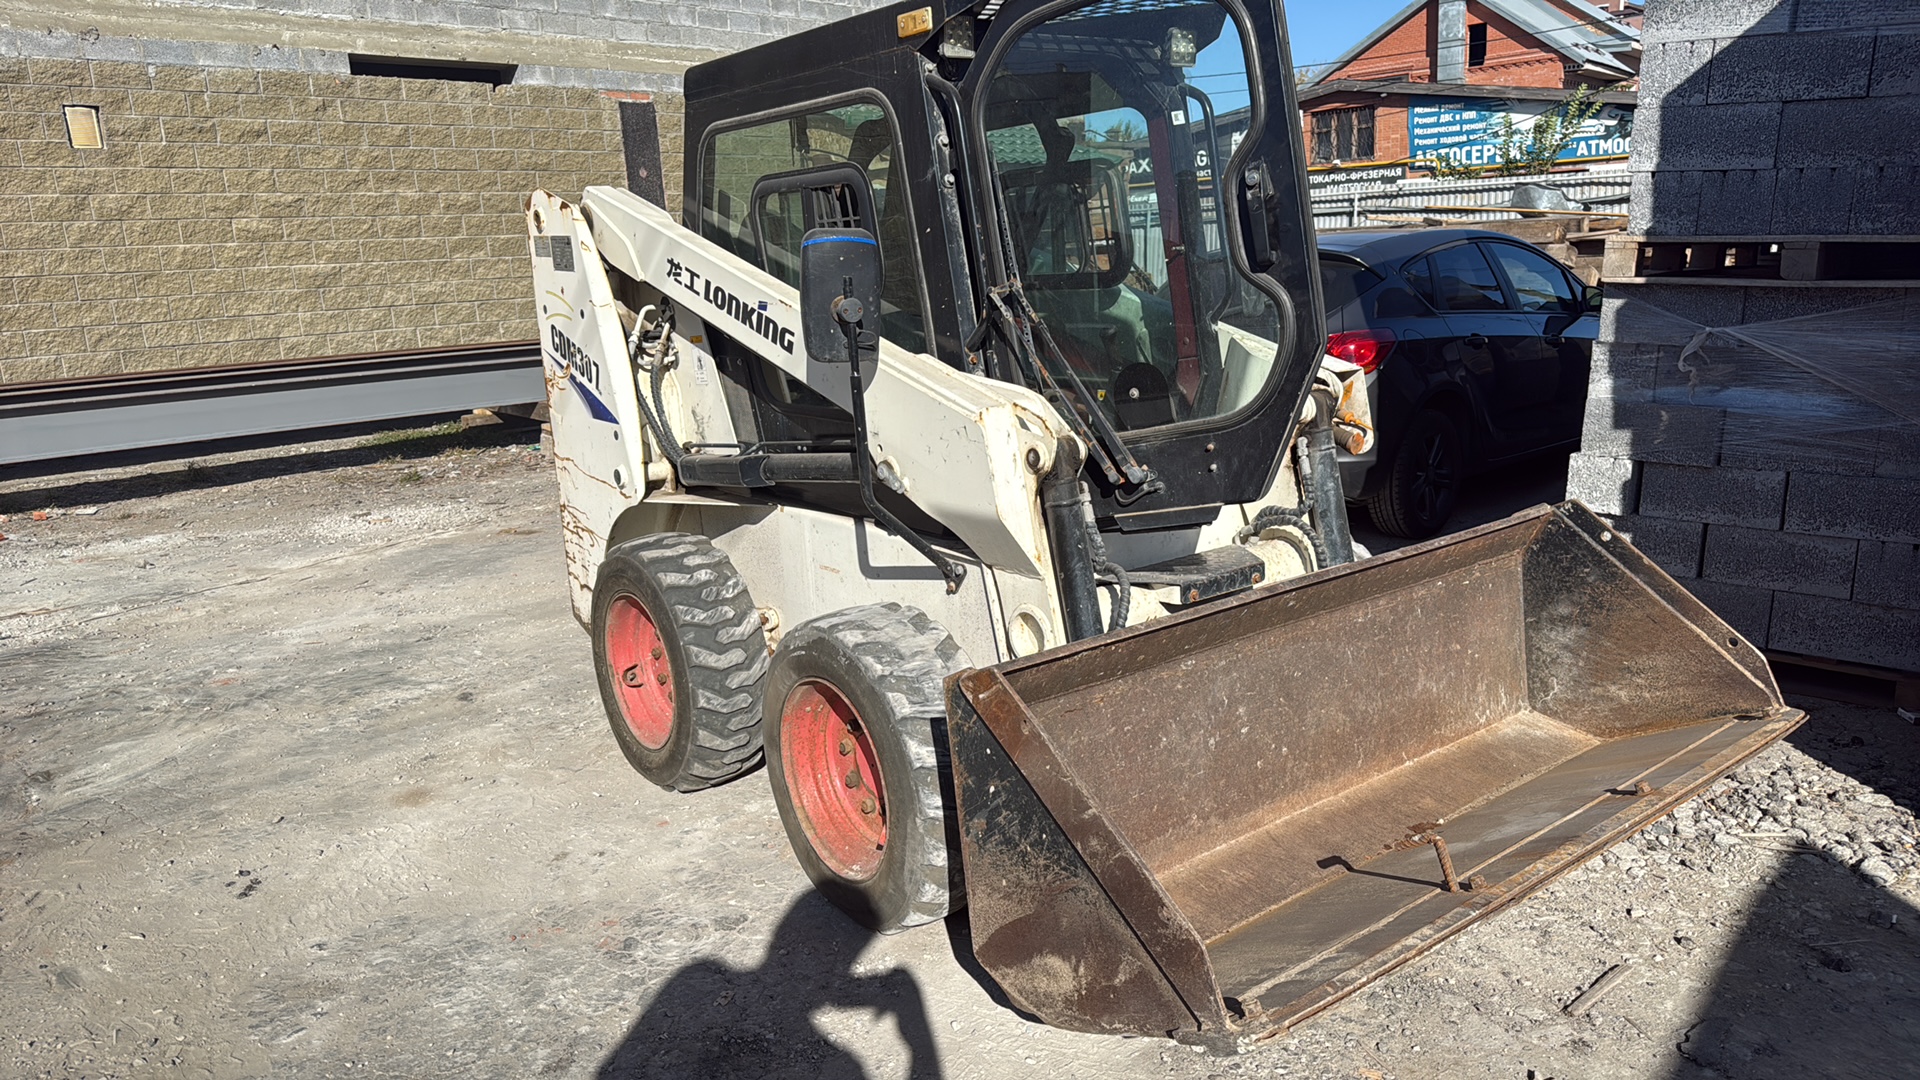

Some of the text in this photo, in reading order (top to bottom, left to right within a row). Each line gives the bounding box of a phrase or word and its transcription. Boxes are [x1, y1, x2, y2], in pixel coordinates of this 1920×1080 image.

[1414, 116, 1438, 125] Ремонт
[1439, 113, 1454, 123] ДВС
[1462, 111, 1476, 120] КПП
[1414, 121, 1487, 135] Механический ремонт
[1414, 137, 1438, 146] Ремонт
[1440, 134, 1467, 144] ходовой
[1308, 167, 1403, 184] ТОКАРНО-ФРЕЗЕРНАЯ
[550, 324, 602, 394] CDM307
